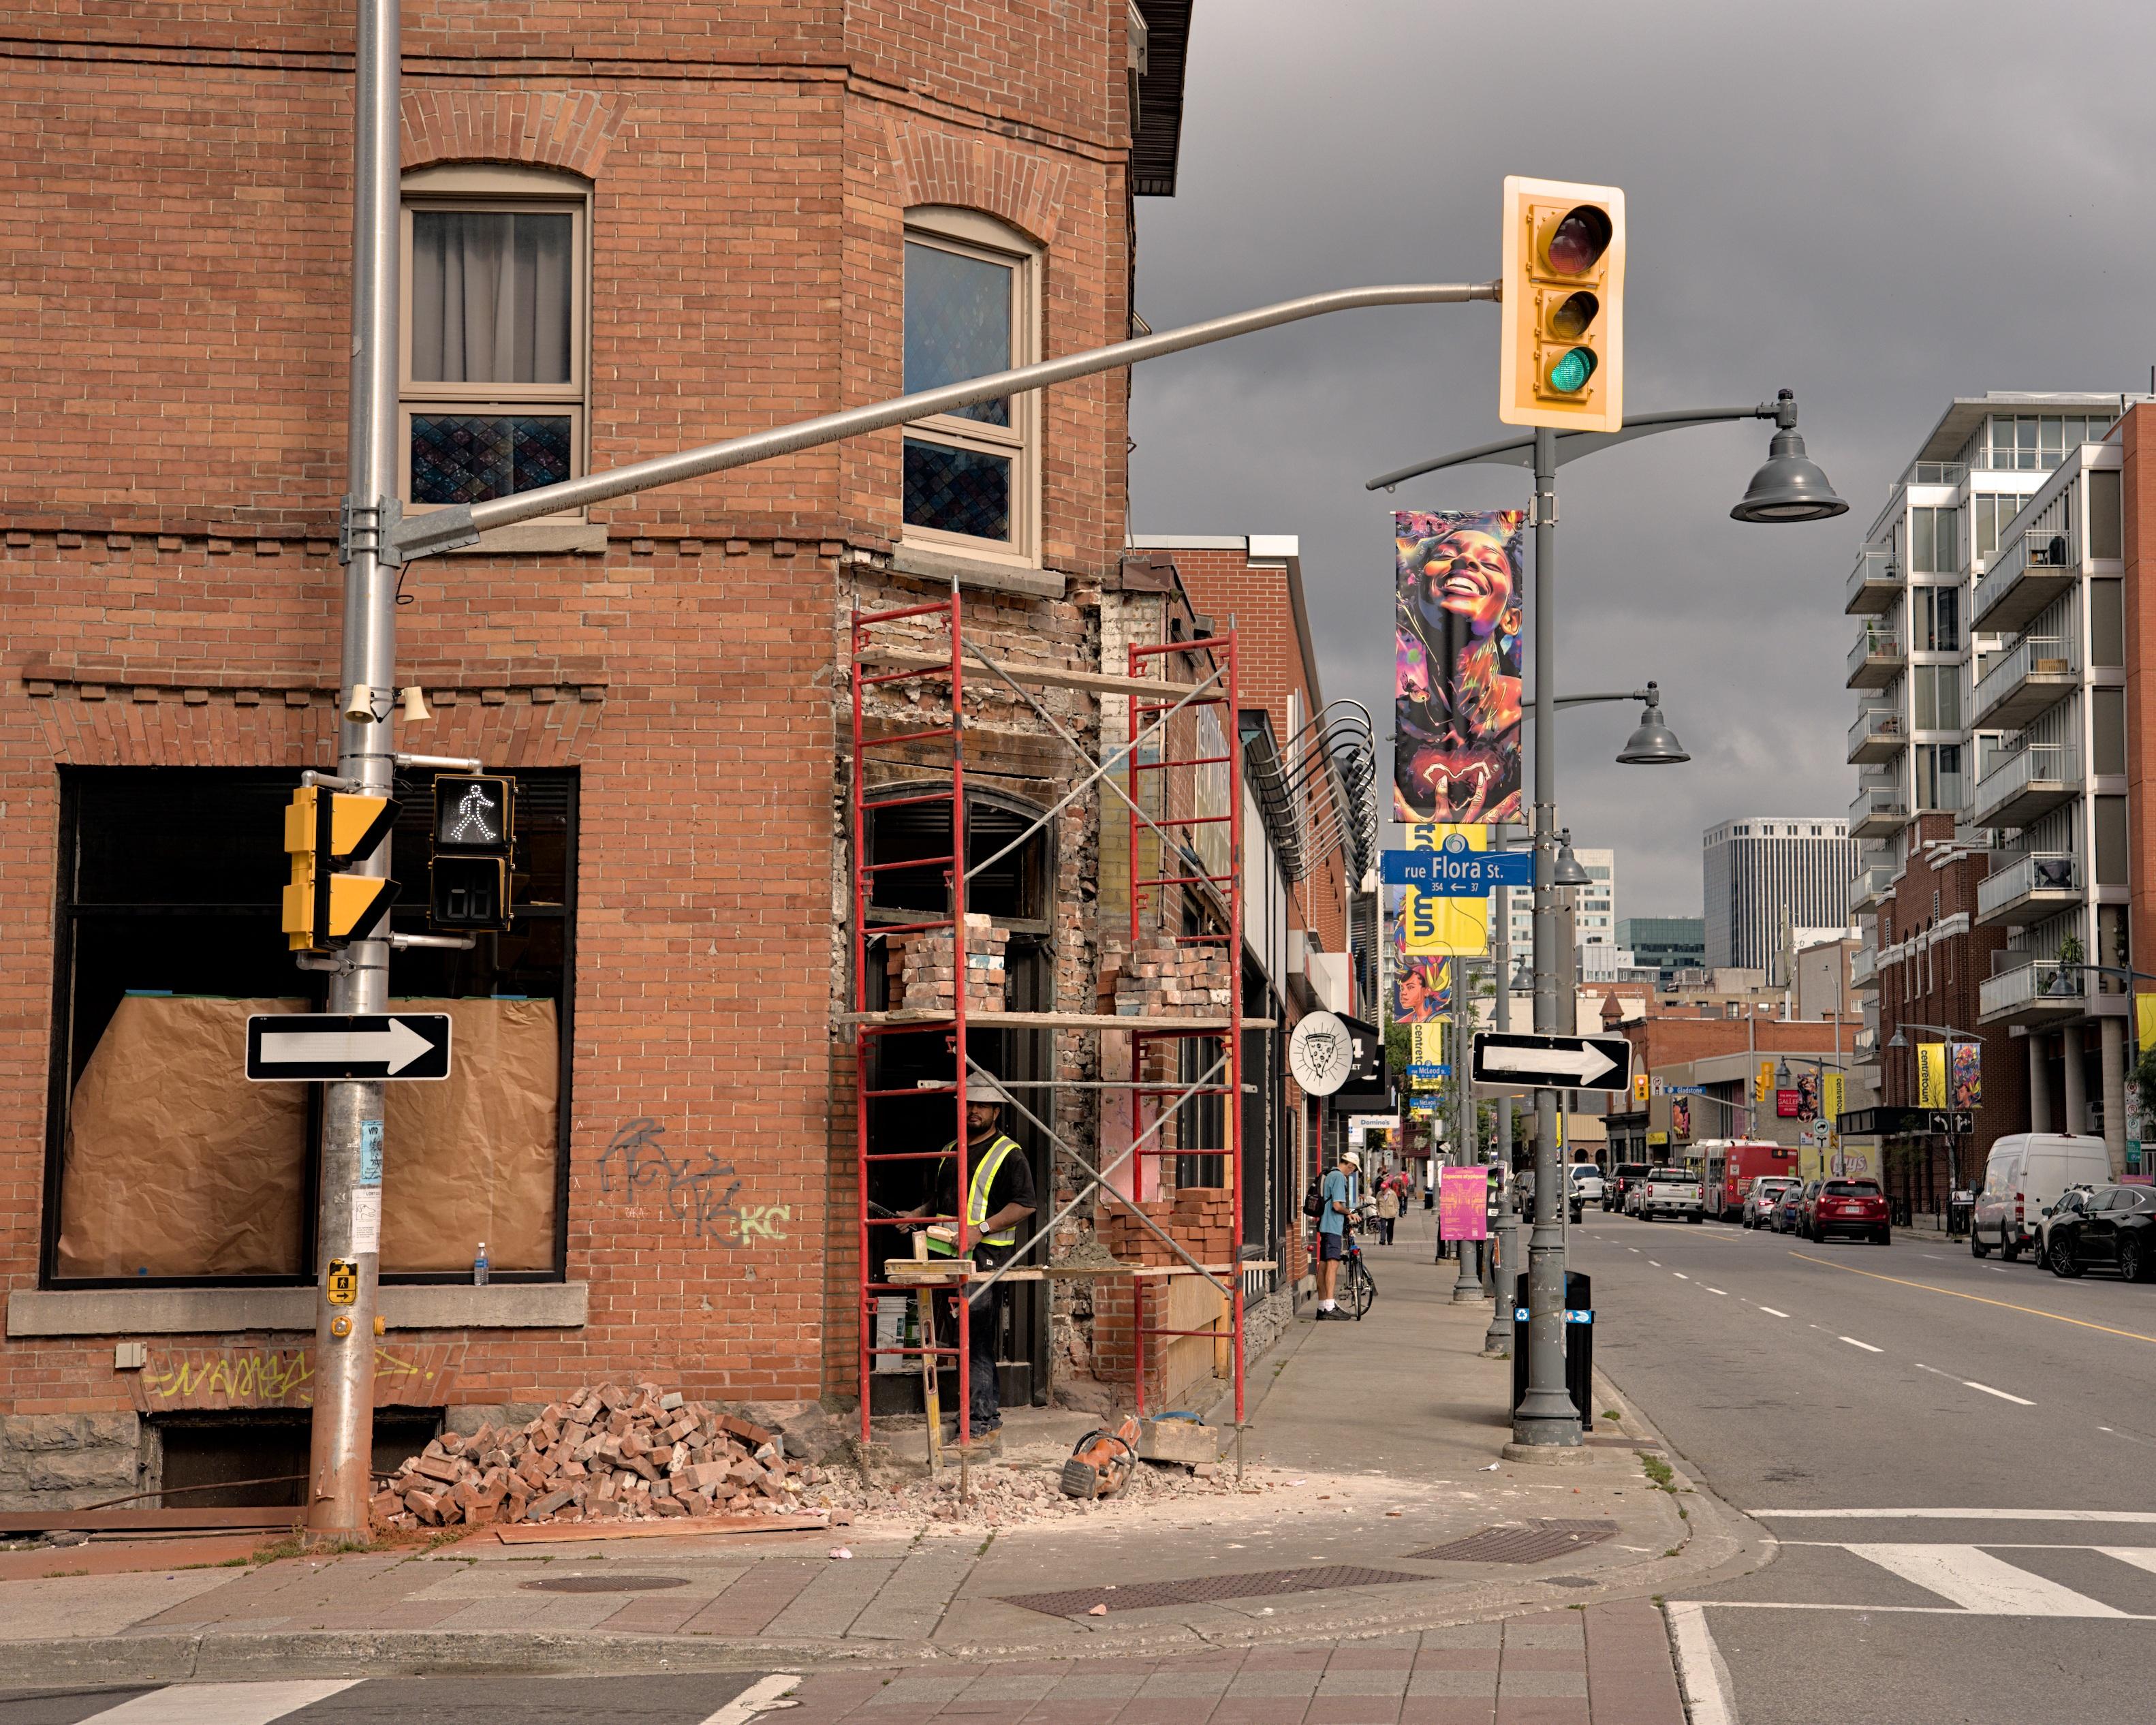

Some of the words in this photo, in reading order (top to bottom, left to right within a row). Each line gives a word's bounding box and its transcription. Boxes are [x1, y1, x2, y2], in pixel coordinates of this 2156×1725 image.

[1405, 866, 1426, 878] rue
[1432, 855, 1481, 879] Flora
[1487, 864, 1504, 879] St.
[1431, 882, 1443, 892] 354
[1471, 882, 1479, 892] 37
[1415, 1025, 1423, 1081] centreto
[1921, 1050, 1929, 1102] centretown
